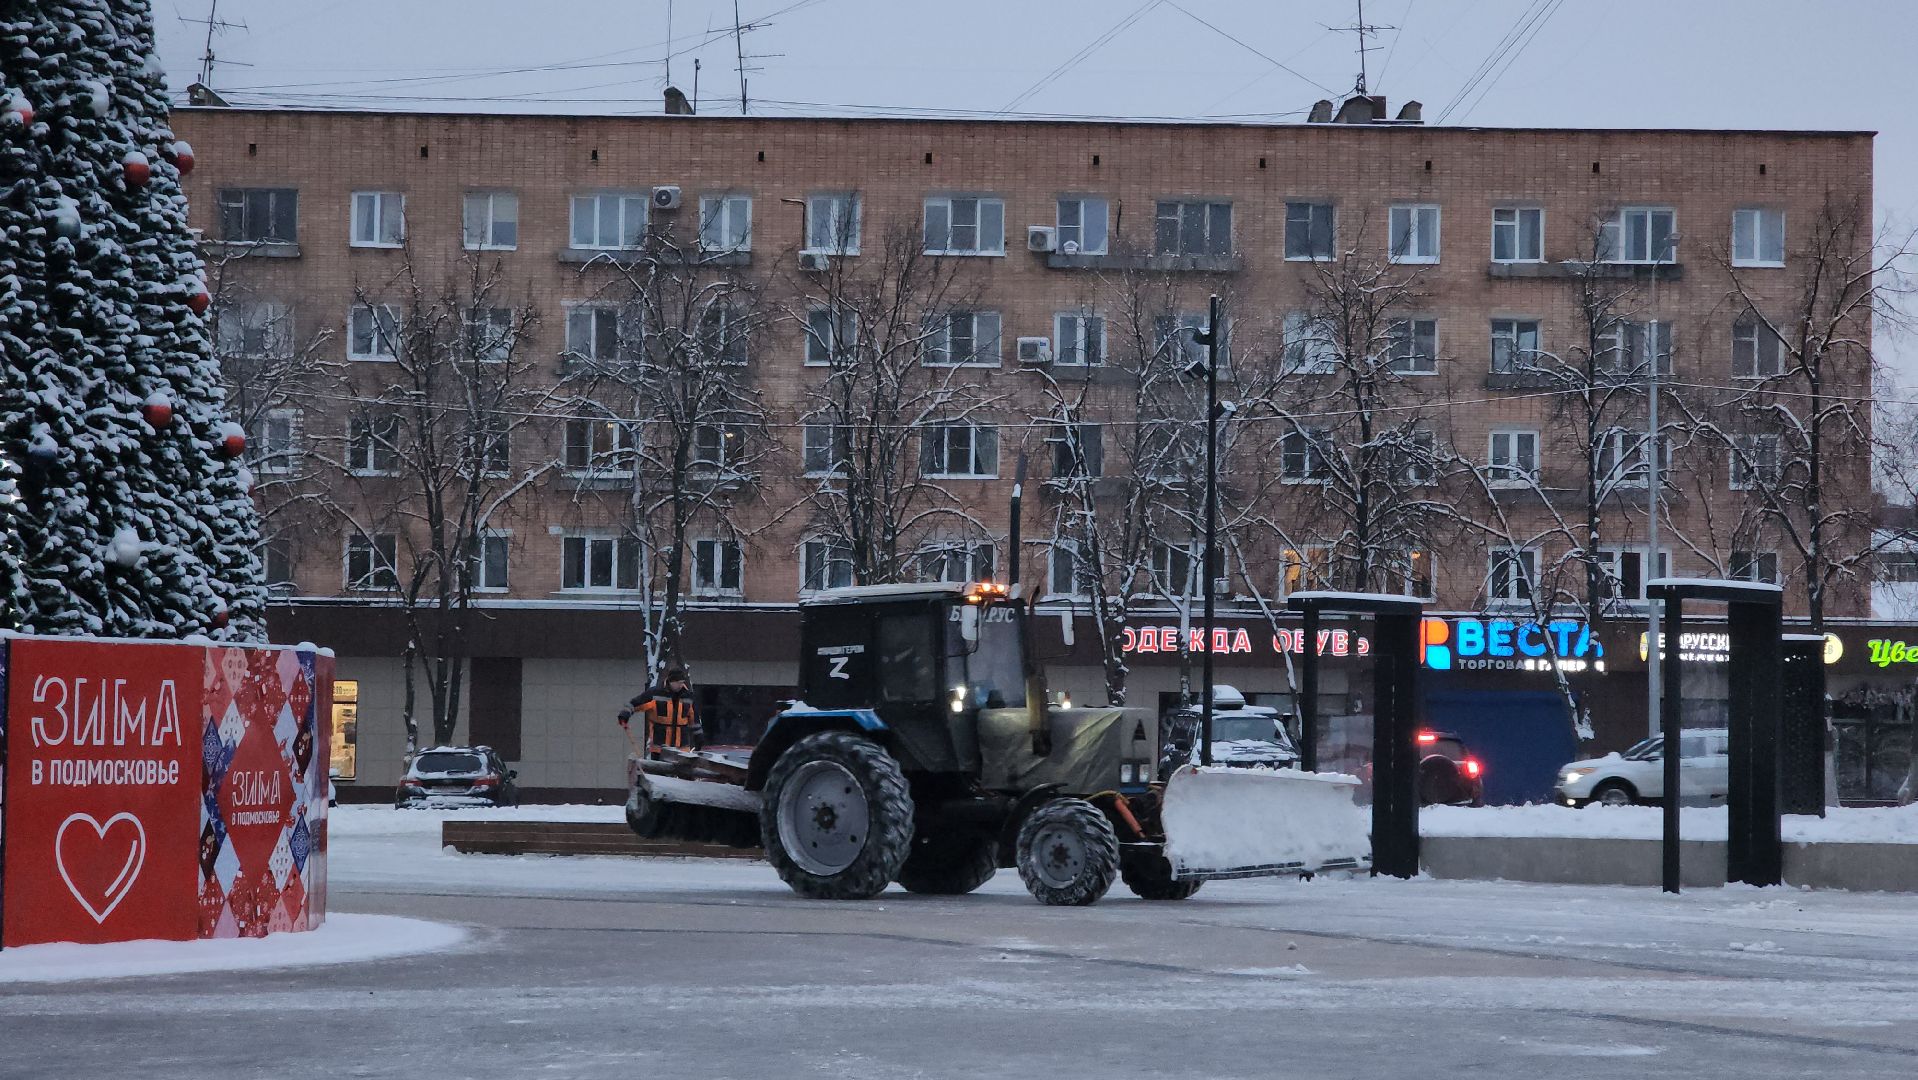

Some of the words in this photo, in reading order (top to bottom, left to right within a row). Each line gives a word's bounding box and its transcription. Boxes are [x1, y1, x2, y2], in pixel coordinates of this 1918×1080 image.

[1457, 620, 1604, 658] ВЕСТА
[830, 656, 849, 679] Z
[1458, 658, 1535, 671] ТОРГОВАЯ
[31, 674, 182, 748] ЗИМА
[31, 759, 43, 785] В
[232, 770, 281, 807] ЗИМА
